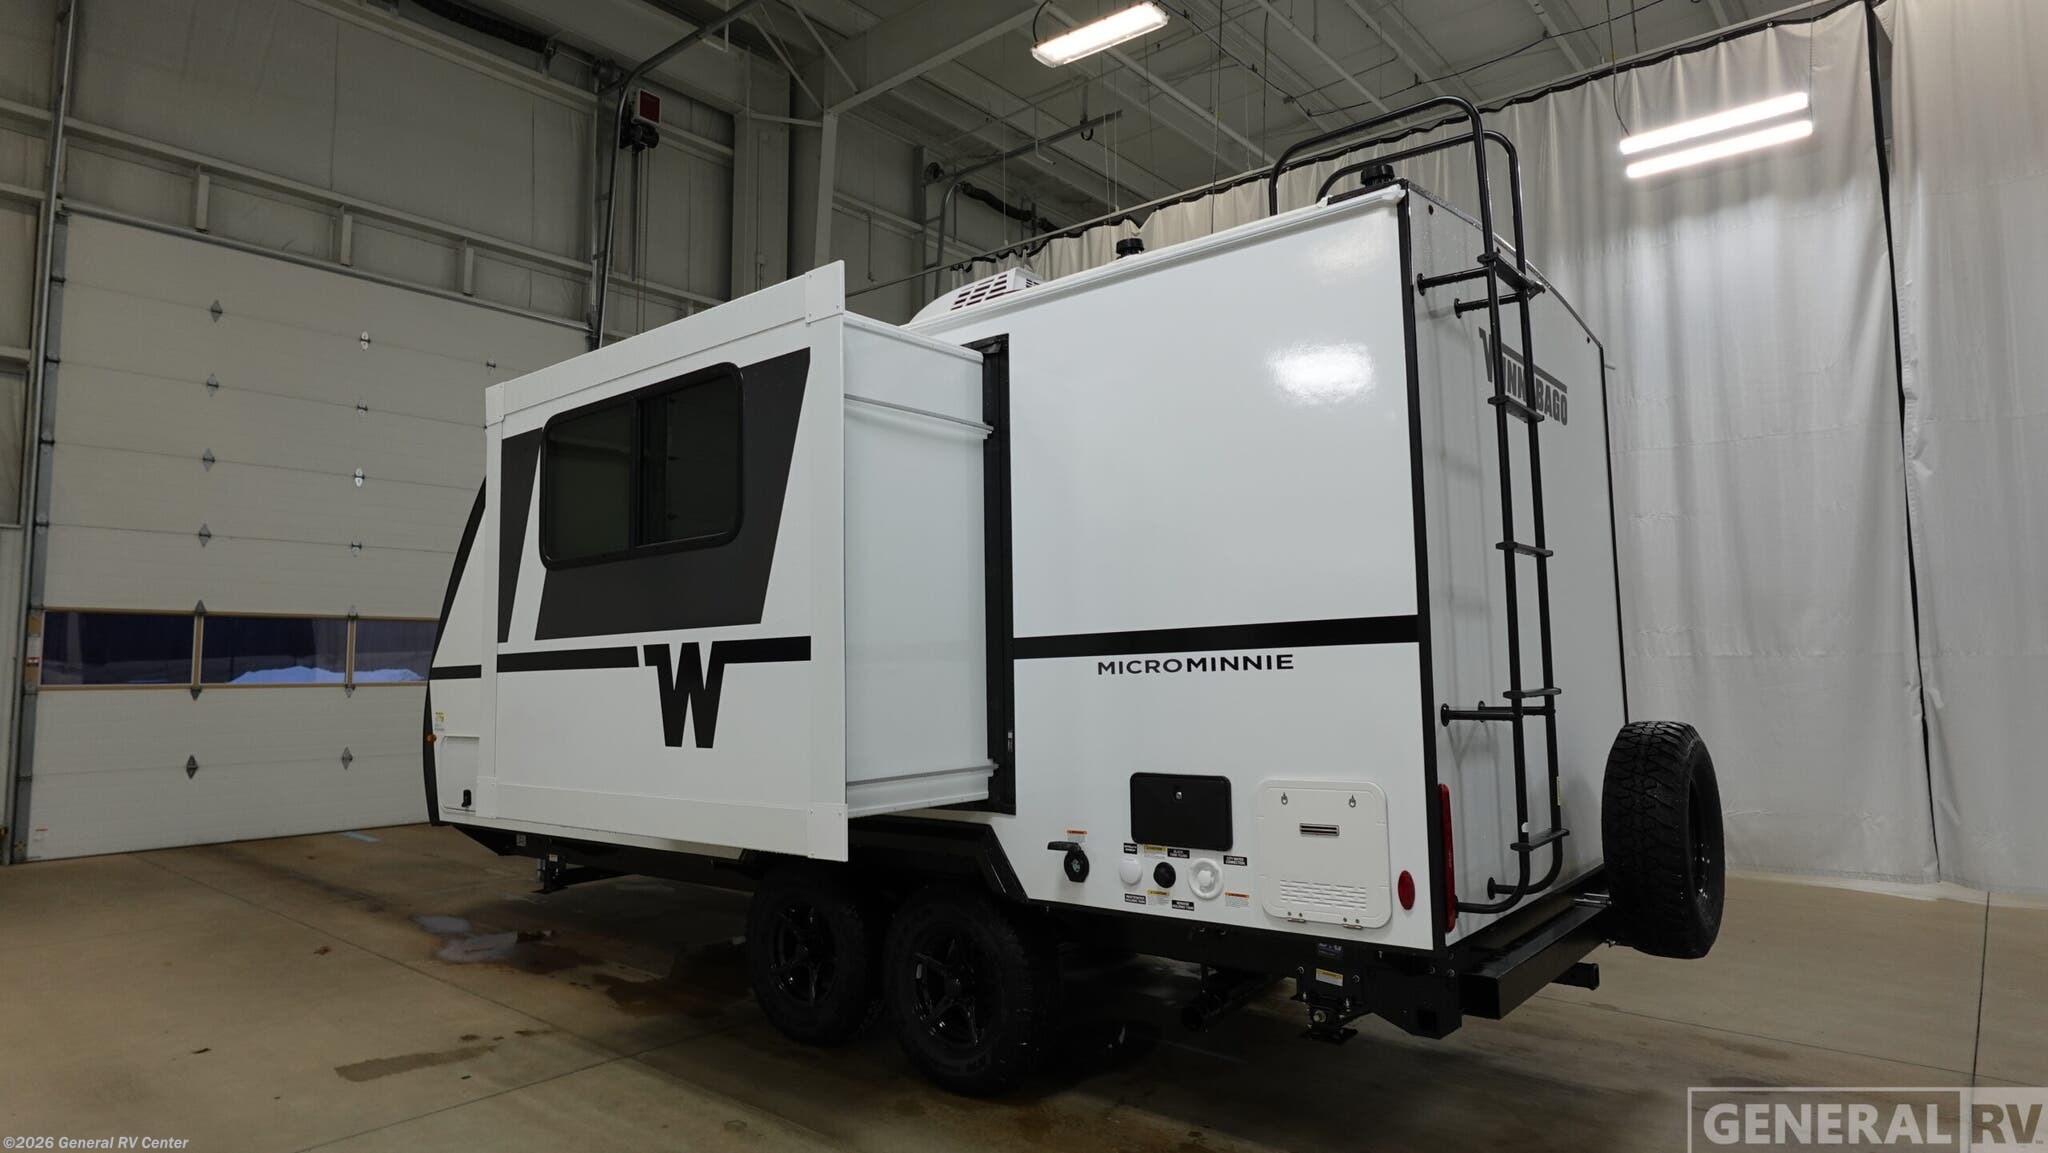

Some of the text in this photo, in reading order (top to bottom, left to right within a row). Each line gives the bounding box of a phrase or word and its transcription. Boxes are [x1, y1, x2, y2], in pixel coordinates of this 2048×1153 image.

[1479, 327, 1567, 426] WNNBAGO
[643, 638, 742, 749] W
[1097, 653, 1294, 676] MICROMINNIE
